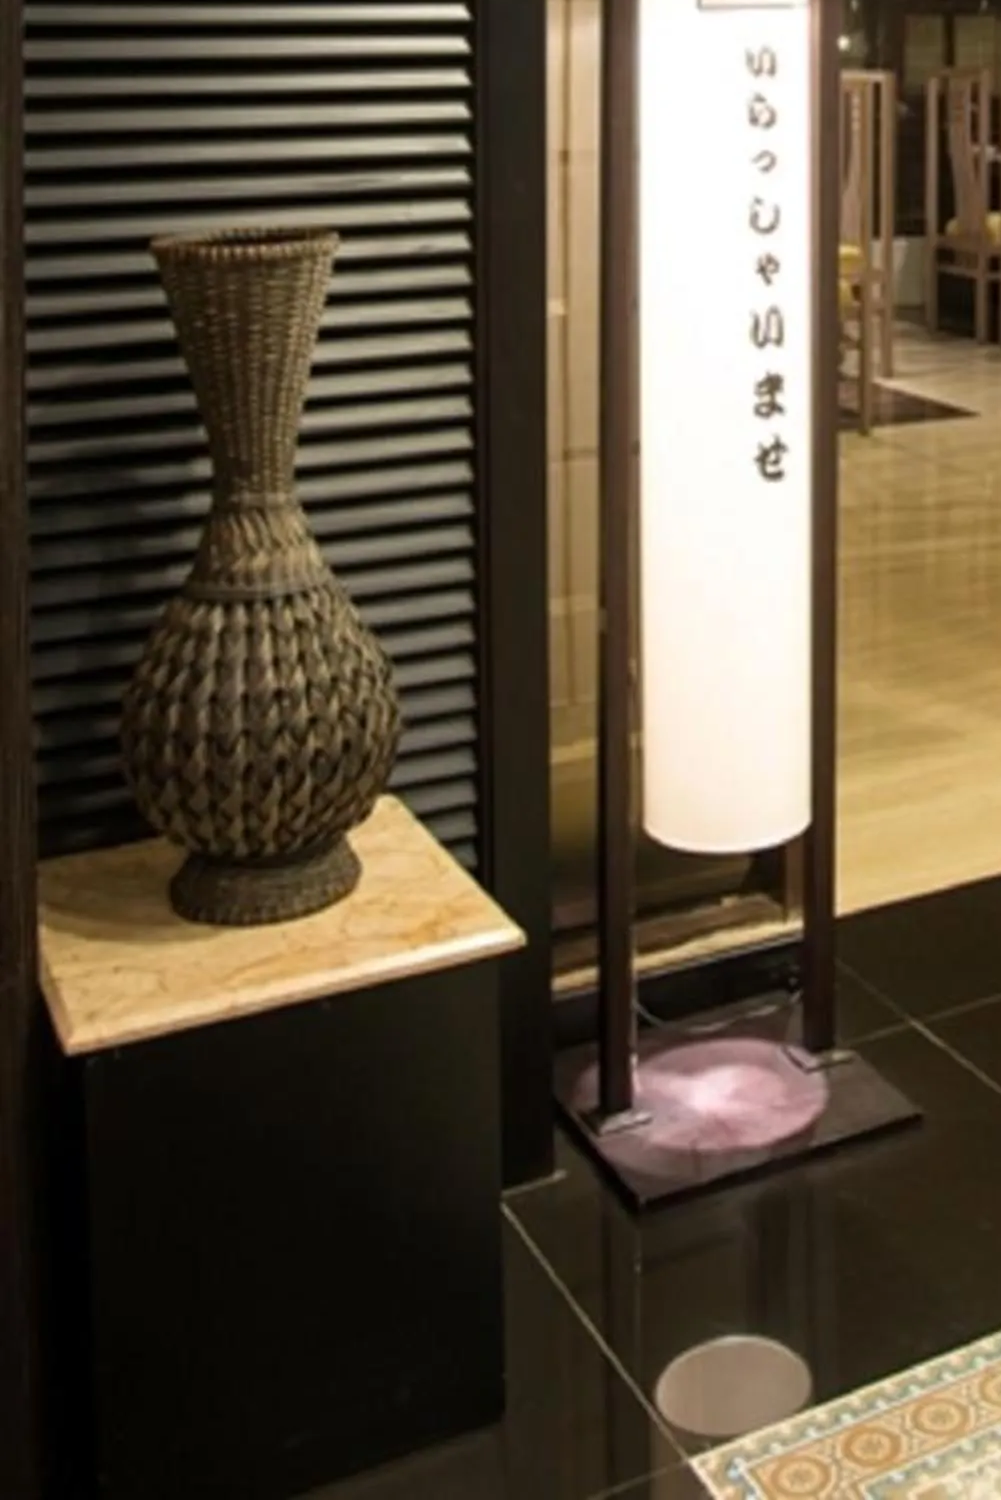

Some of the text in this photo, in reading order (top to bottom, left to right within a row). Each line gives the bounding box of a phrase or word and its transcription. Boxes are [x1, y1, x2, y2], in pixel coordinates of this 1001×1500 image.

[745, 46, 789, 483] いらっしゃいませ
